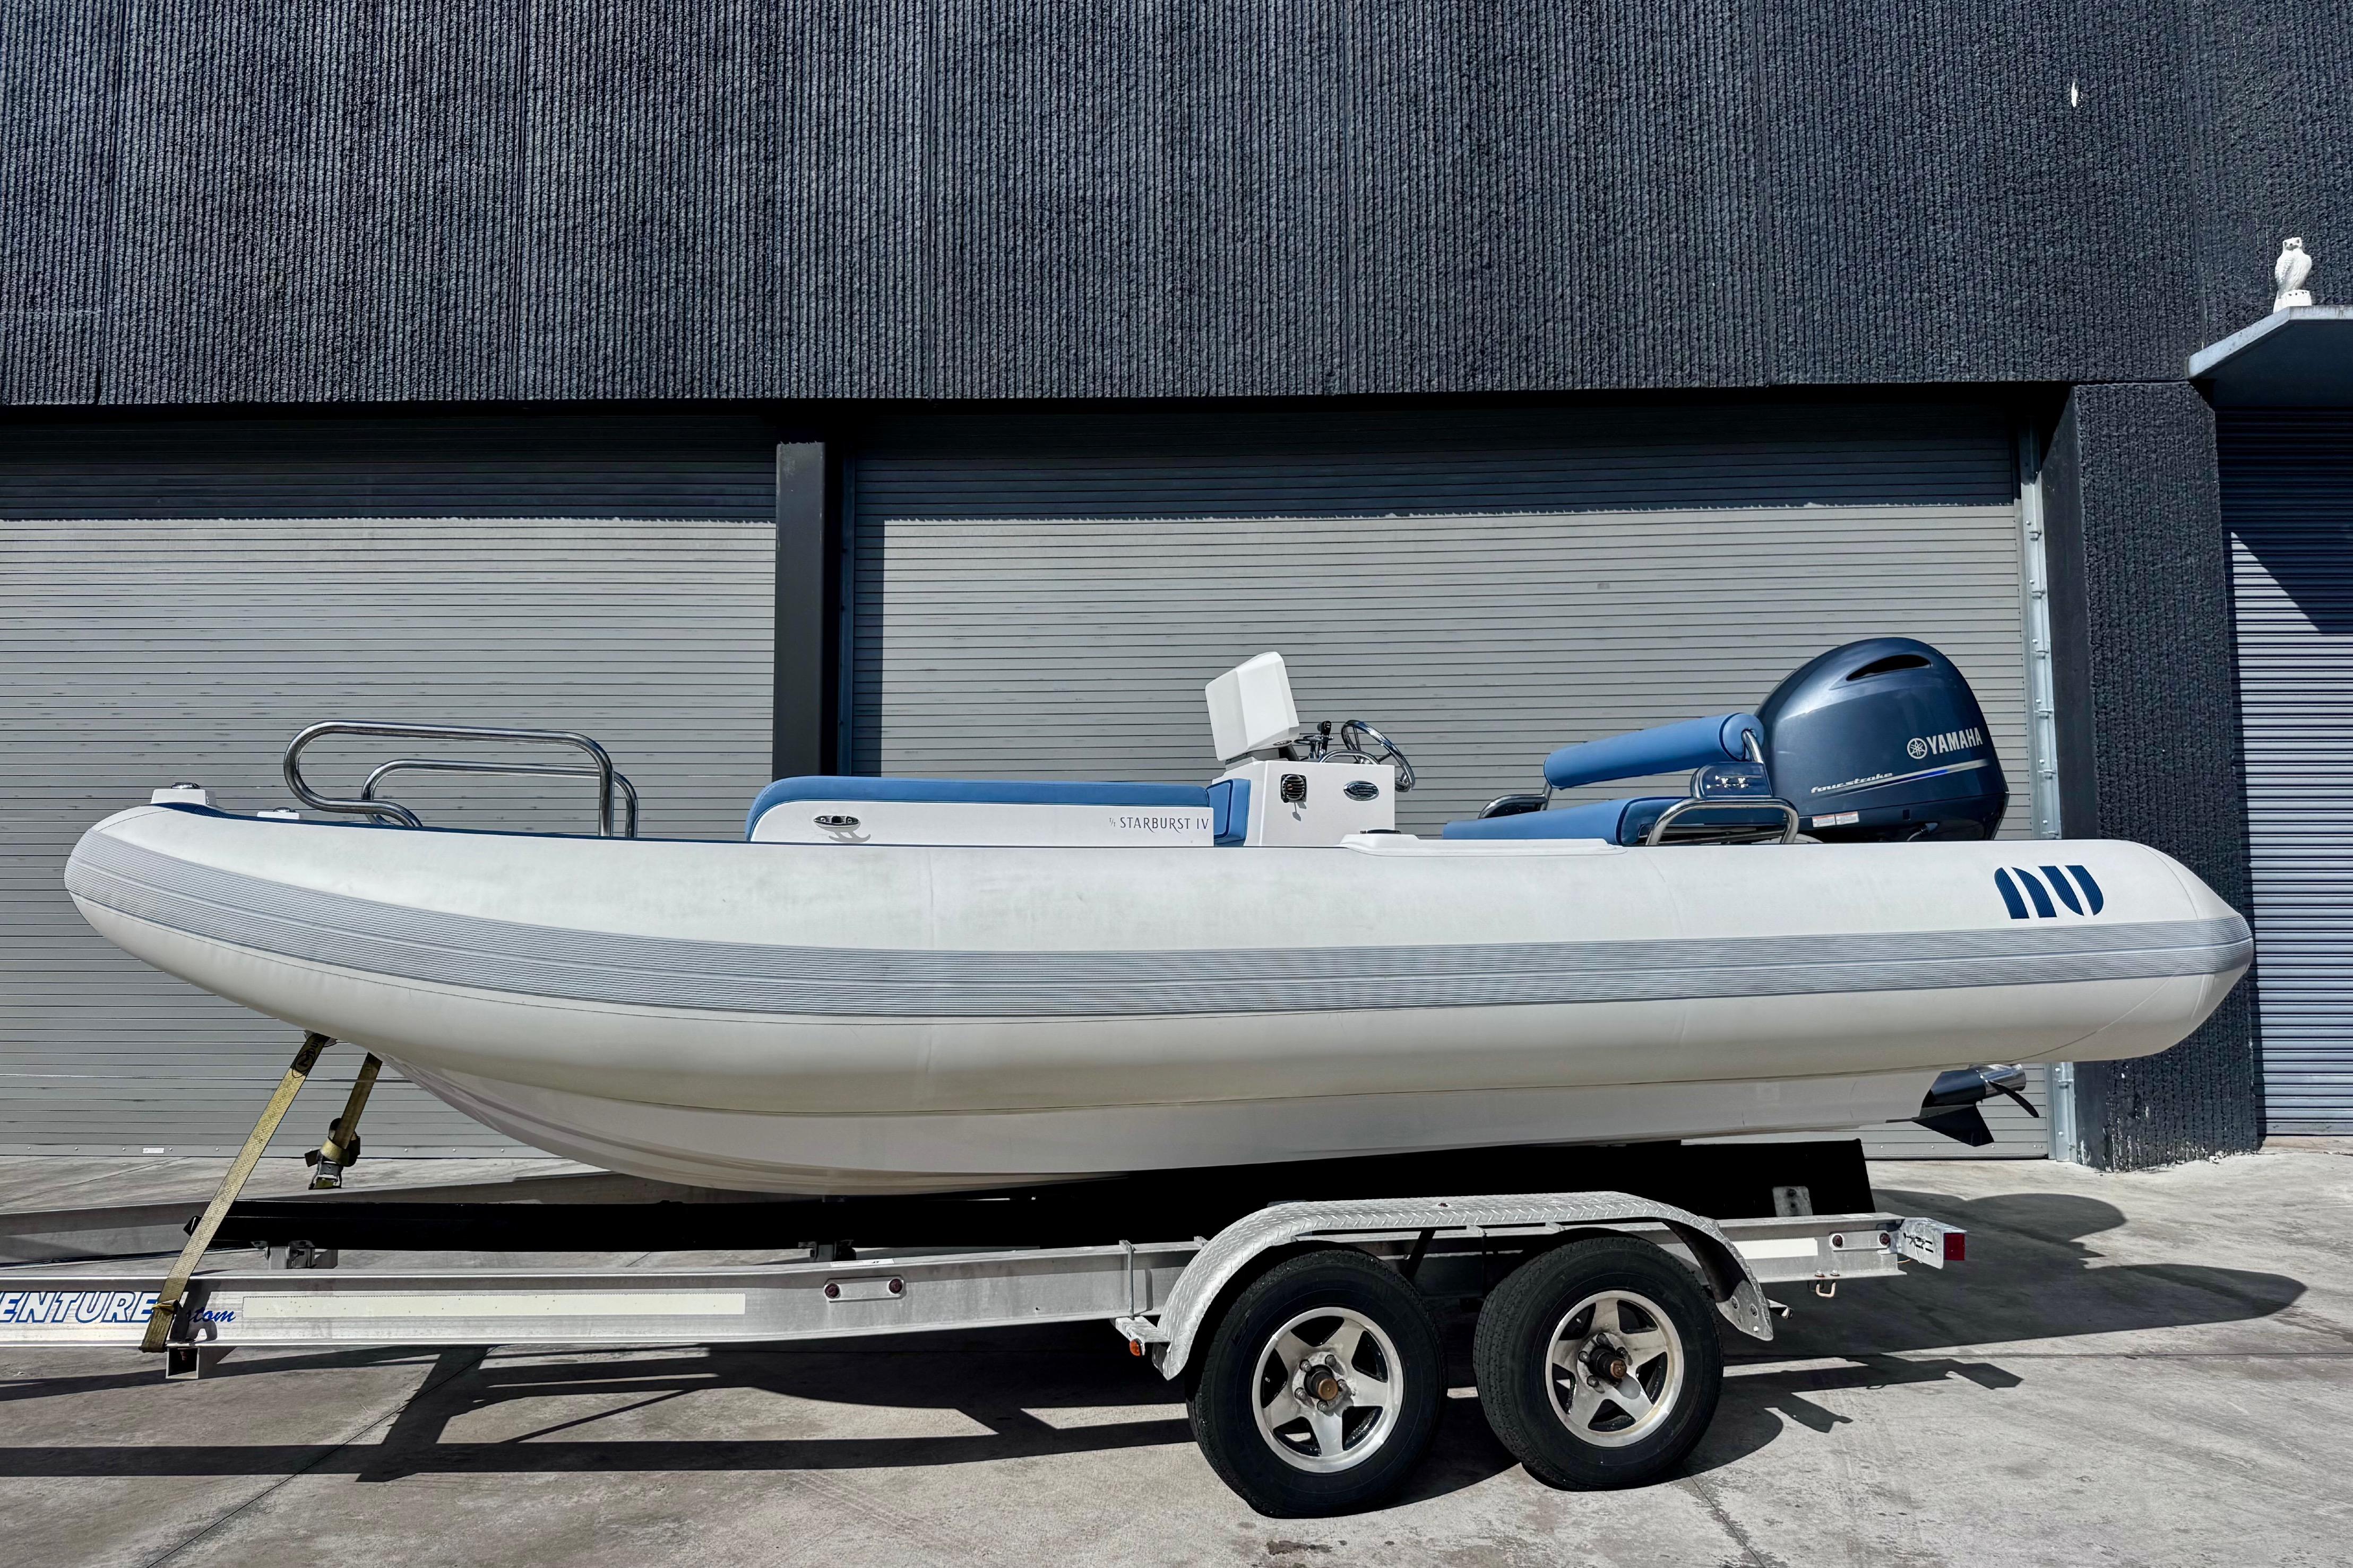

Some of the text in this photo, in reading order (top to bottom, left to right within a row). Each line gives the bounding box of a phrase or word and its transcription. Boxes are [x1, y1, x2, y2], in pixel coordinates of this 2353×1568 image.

[1926, 727, 1983, 755] YAMAHA
[1120, 817, 1191, 834] STARBURST
[1196, 818, 1209, 829] IV
[0, 1290, 236, 1323] ENTURE stom
